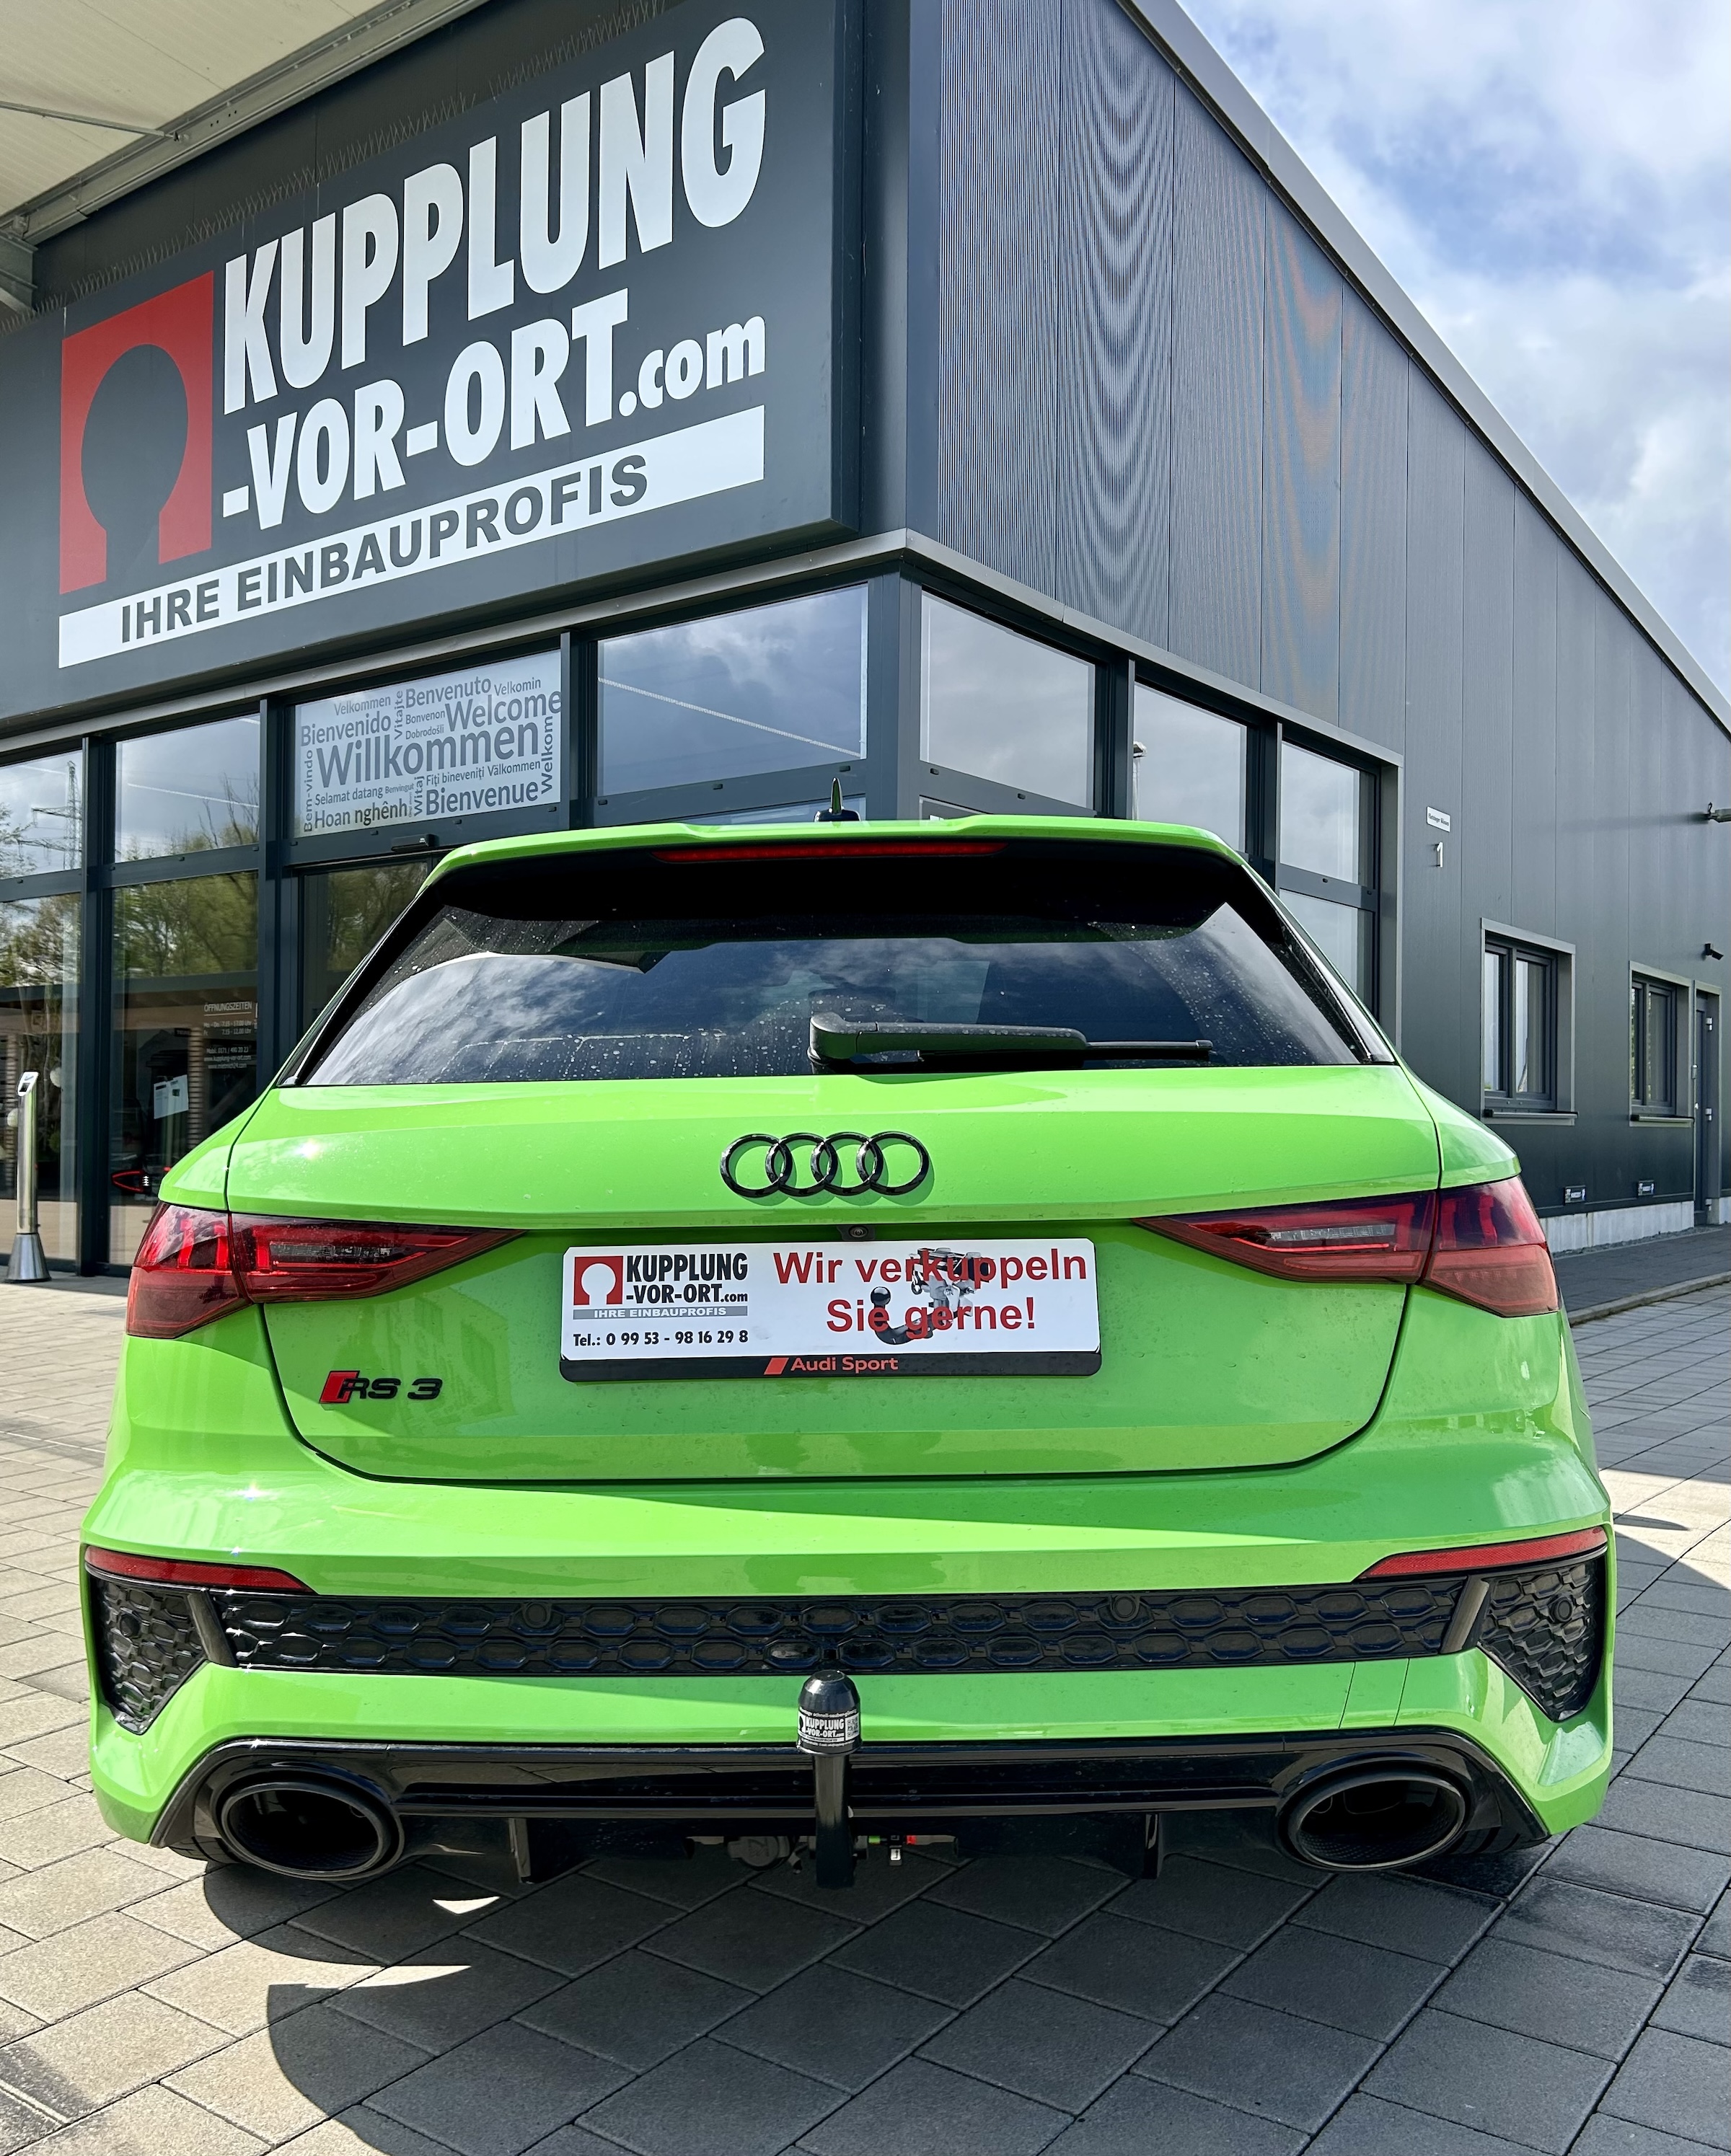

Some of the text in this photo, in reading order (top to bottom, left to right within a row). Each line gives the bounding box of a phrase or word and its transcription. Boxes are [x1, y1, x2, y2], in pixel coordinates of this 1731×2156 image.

[223, 17, 767, 415] KUPPLUNG
[222, 287, 767, 530] -VOR-ORT.com
[120, 454, 648, 644] IHRE EINBAUPROFIS
[405, 676, 492, 709] Benvenuto
[494, 677, 541, 697] Velkomin
[334, 696, 391, 716] Velkommen
[394, 690, 405, 741] Vitajte
[405, 710, 446, 725] Bonvenon
[445, 690, 562, 733] Welcome
[301, 710, 392, 747] Bienvenido
[316, 721, 539, 787] Willkommen
[487, 760, 541, 777] Välkommen
[541, 715, 553, 795] Welkom
[304, 750, 313, 832] Bem-vindo
[314, 787, 383, 806] Selamat datang
[413, 776, 425, 817] Witaj
[426, 782, 539, 816] Bienvenue
[314, 808, 351, 829] Hoan
[355, 798, 408, 826] nghênh
[1437, 841, 1443, 867] 1
[626, 1252, 748, 1283] KUPPLUNG
[773, 1248, 1086, 1289] Wir verkuppeln
[626, 1284, 748, 1304] -VOR-ORT.com
[594, 1307, 727, 1318] IHRE EINBAUPROFIS
[827, 1297, 1036, 1339] Sie gerne!
[573, 1333, 601, 1346] Tel.:
[606, 1333, 616, 1346] 0
[621, 1332, 639, 1346] 99
[644, 1332, 659, 1345] 53
[675, 1331, 693, 1345] 98
[698, 1330, 713, 1344] 16
[717, 1330, 734, 1343] 29
[739, 1330, 749, 1343] 8
[790, 1356, 899, 1374] Audi Sport
[337, 1377, 443, 1400] RS 3
[806, 1716, 845, 1731] KUPPLUNG
